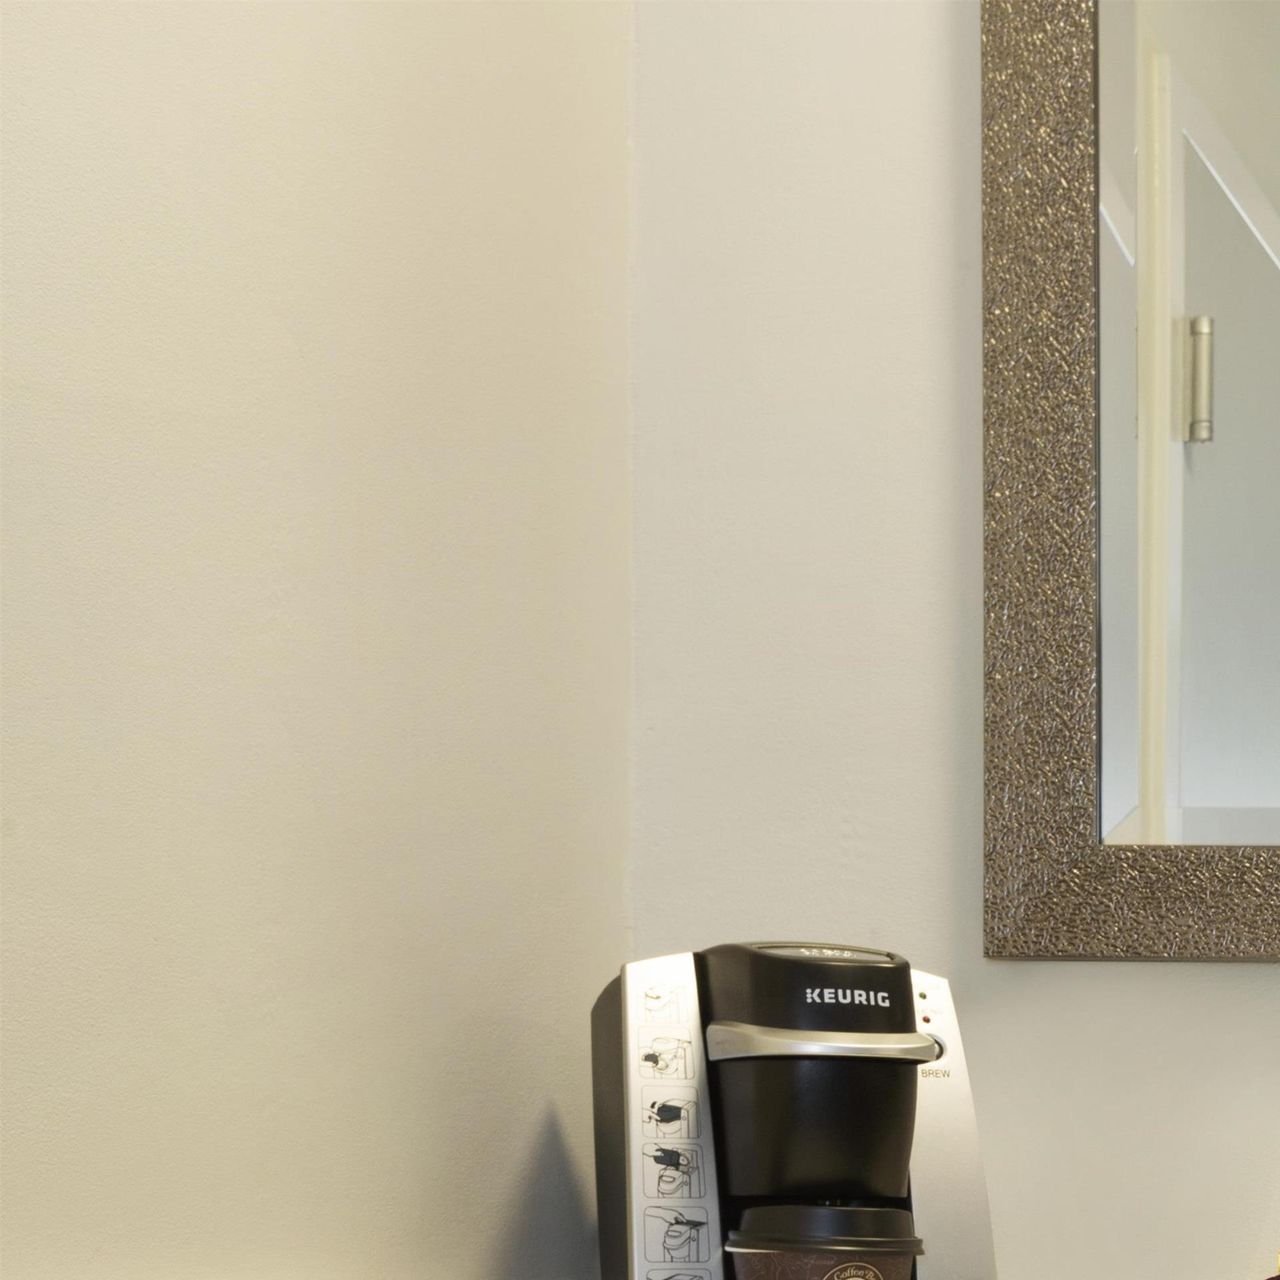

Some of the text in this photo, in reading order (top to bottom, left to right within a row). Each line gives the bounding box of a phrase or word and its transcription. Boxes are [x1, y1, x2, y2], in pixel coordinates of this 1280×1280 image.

[806, 988, 890, 1007] KEURIG
[921, 1069, 951, 1078] BREW
[834, 1267, 864, 1280] Coffee
